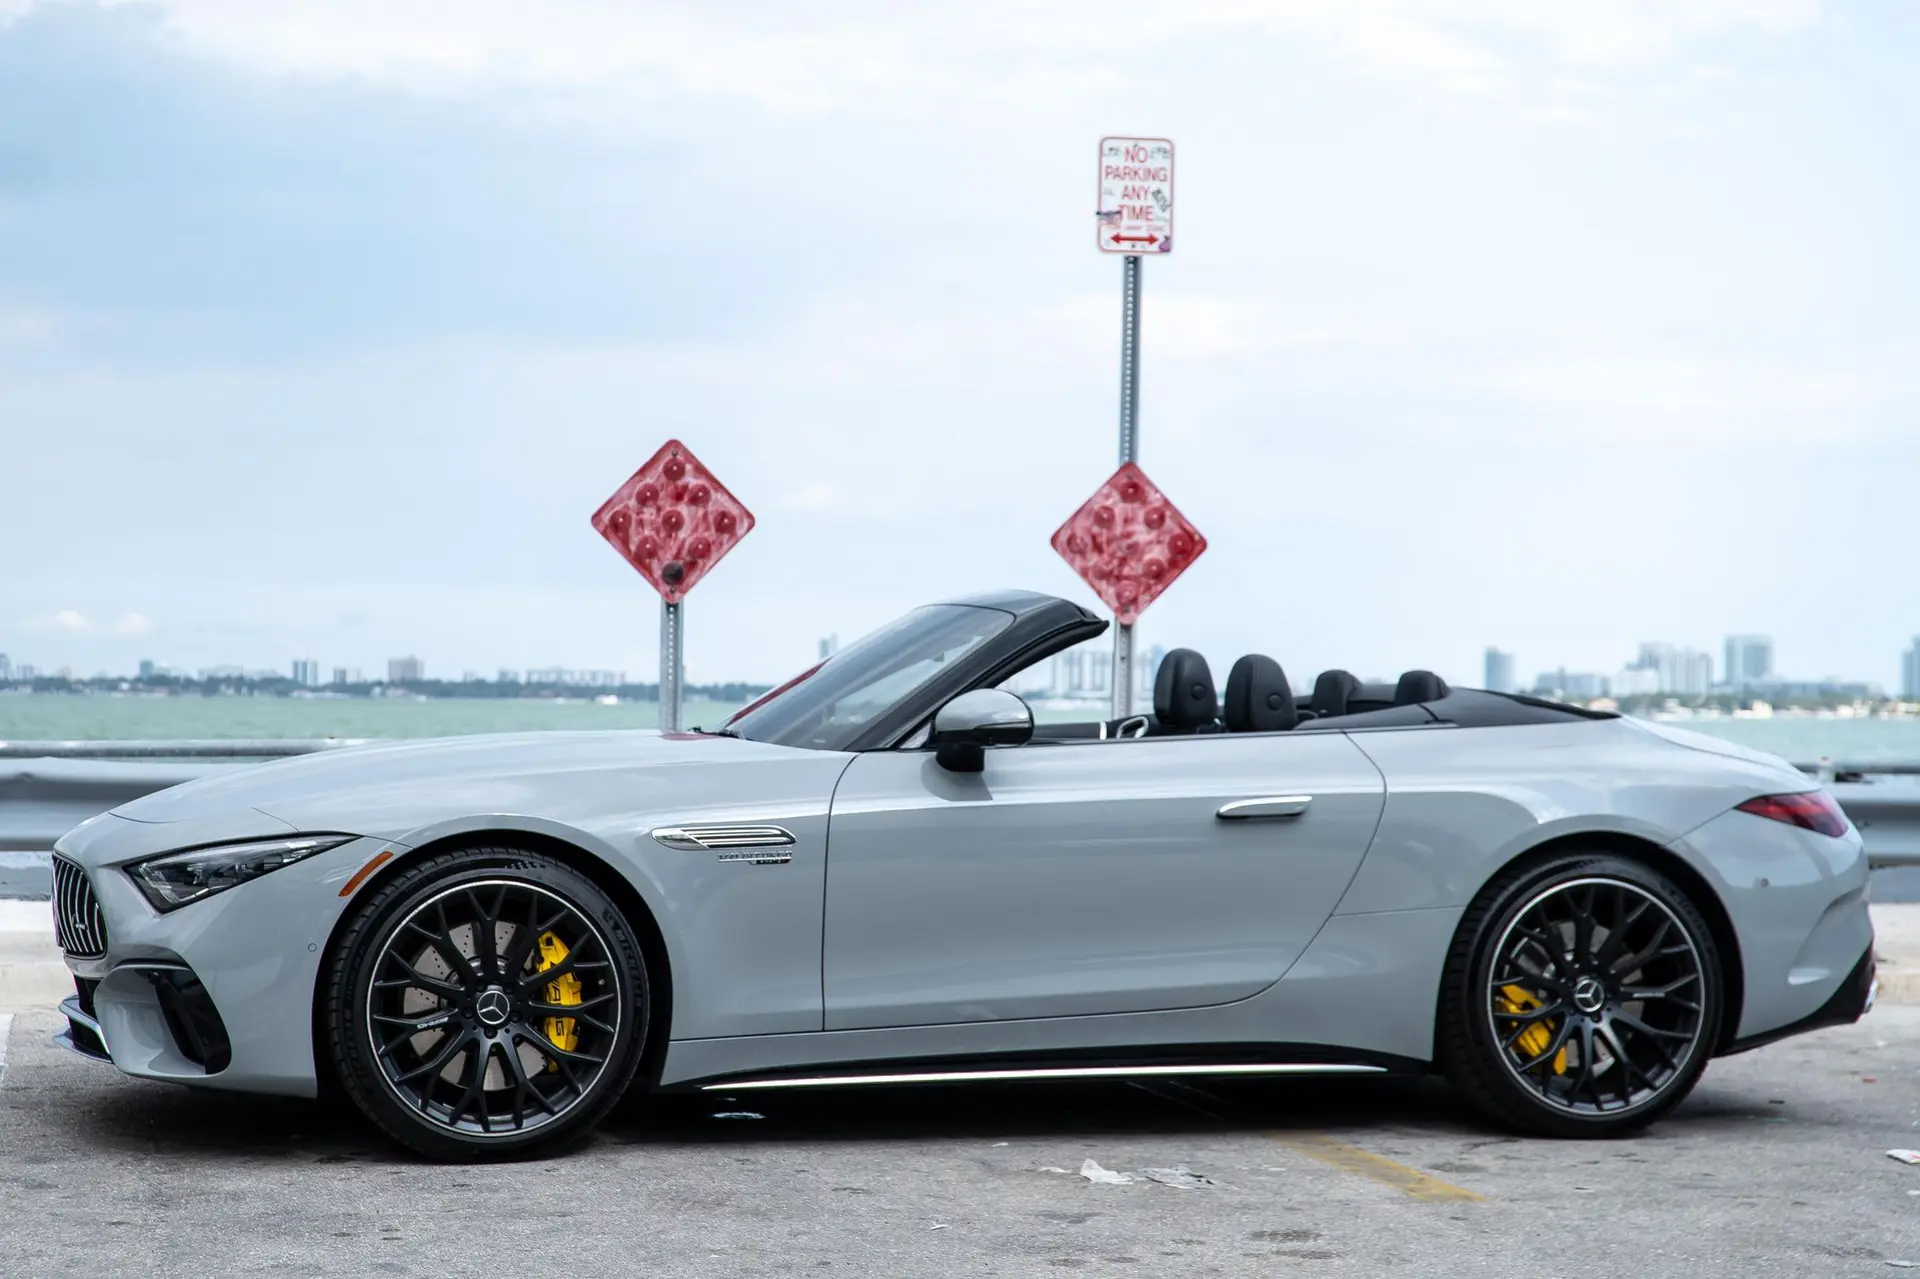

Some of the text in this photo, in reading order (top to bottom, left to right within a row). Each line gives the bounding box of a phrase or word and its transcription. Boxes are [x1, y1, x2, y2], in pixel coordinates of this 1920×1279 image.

[1124, 146, 1148, 163] NO
[1104, 165, 1168, 182] PARKING
[1121, 185, 1150, 200] ANY
[1118, 204, 1154, 222] TIME
